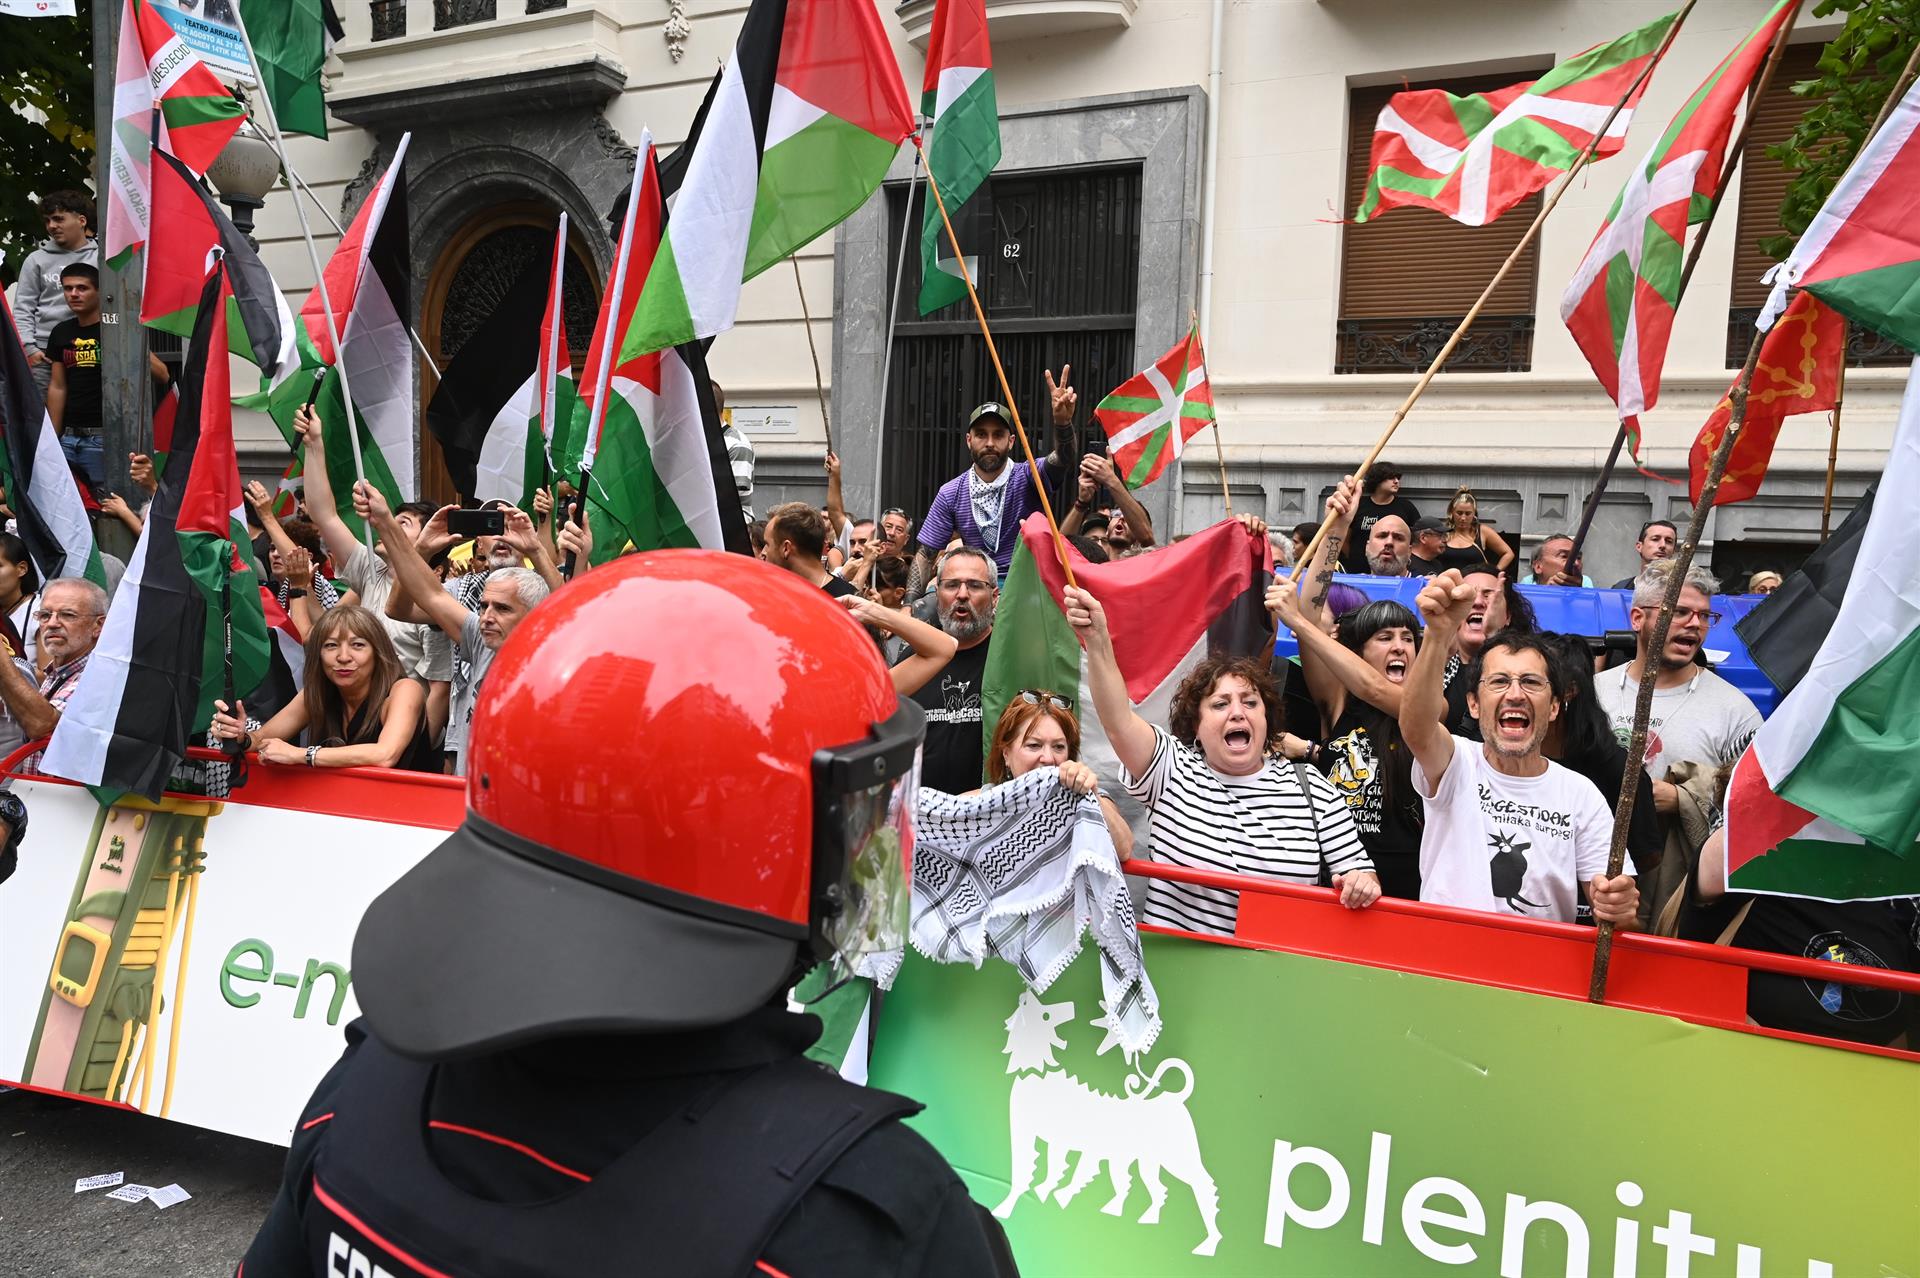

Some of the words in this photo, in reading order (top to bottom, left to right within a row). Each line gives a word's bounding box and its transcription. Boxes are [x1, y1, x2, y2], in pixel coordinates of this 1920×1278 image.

[184, 18, 209, 32] TEATRO
[210, 26, 237, 40] ARRIAGA
[190, 29, 215, 42] AGOSTO
[216, 37, 224, 45] AL
[225, 40, 233, 48] 21
[1003, 244, 1020, 258] 62
[101, 313, 120, 324] 160
